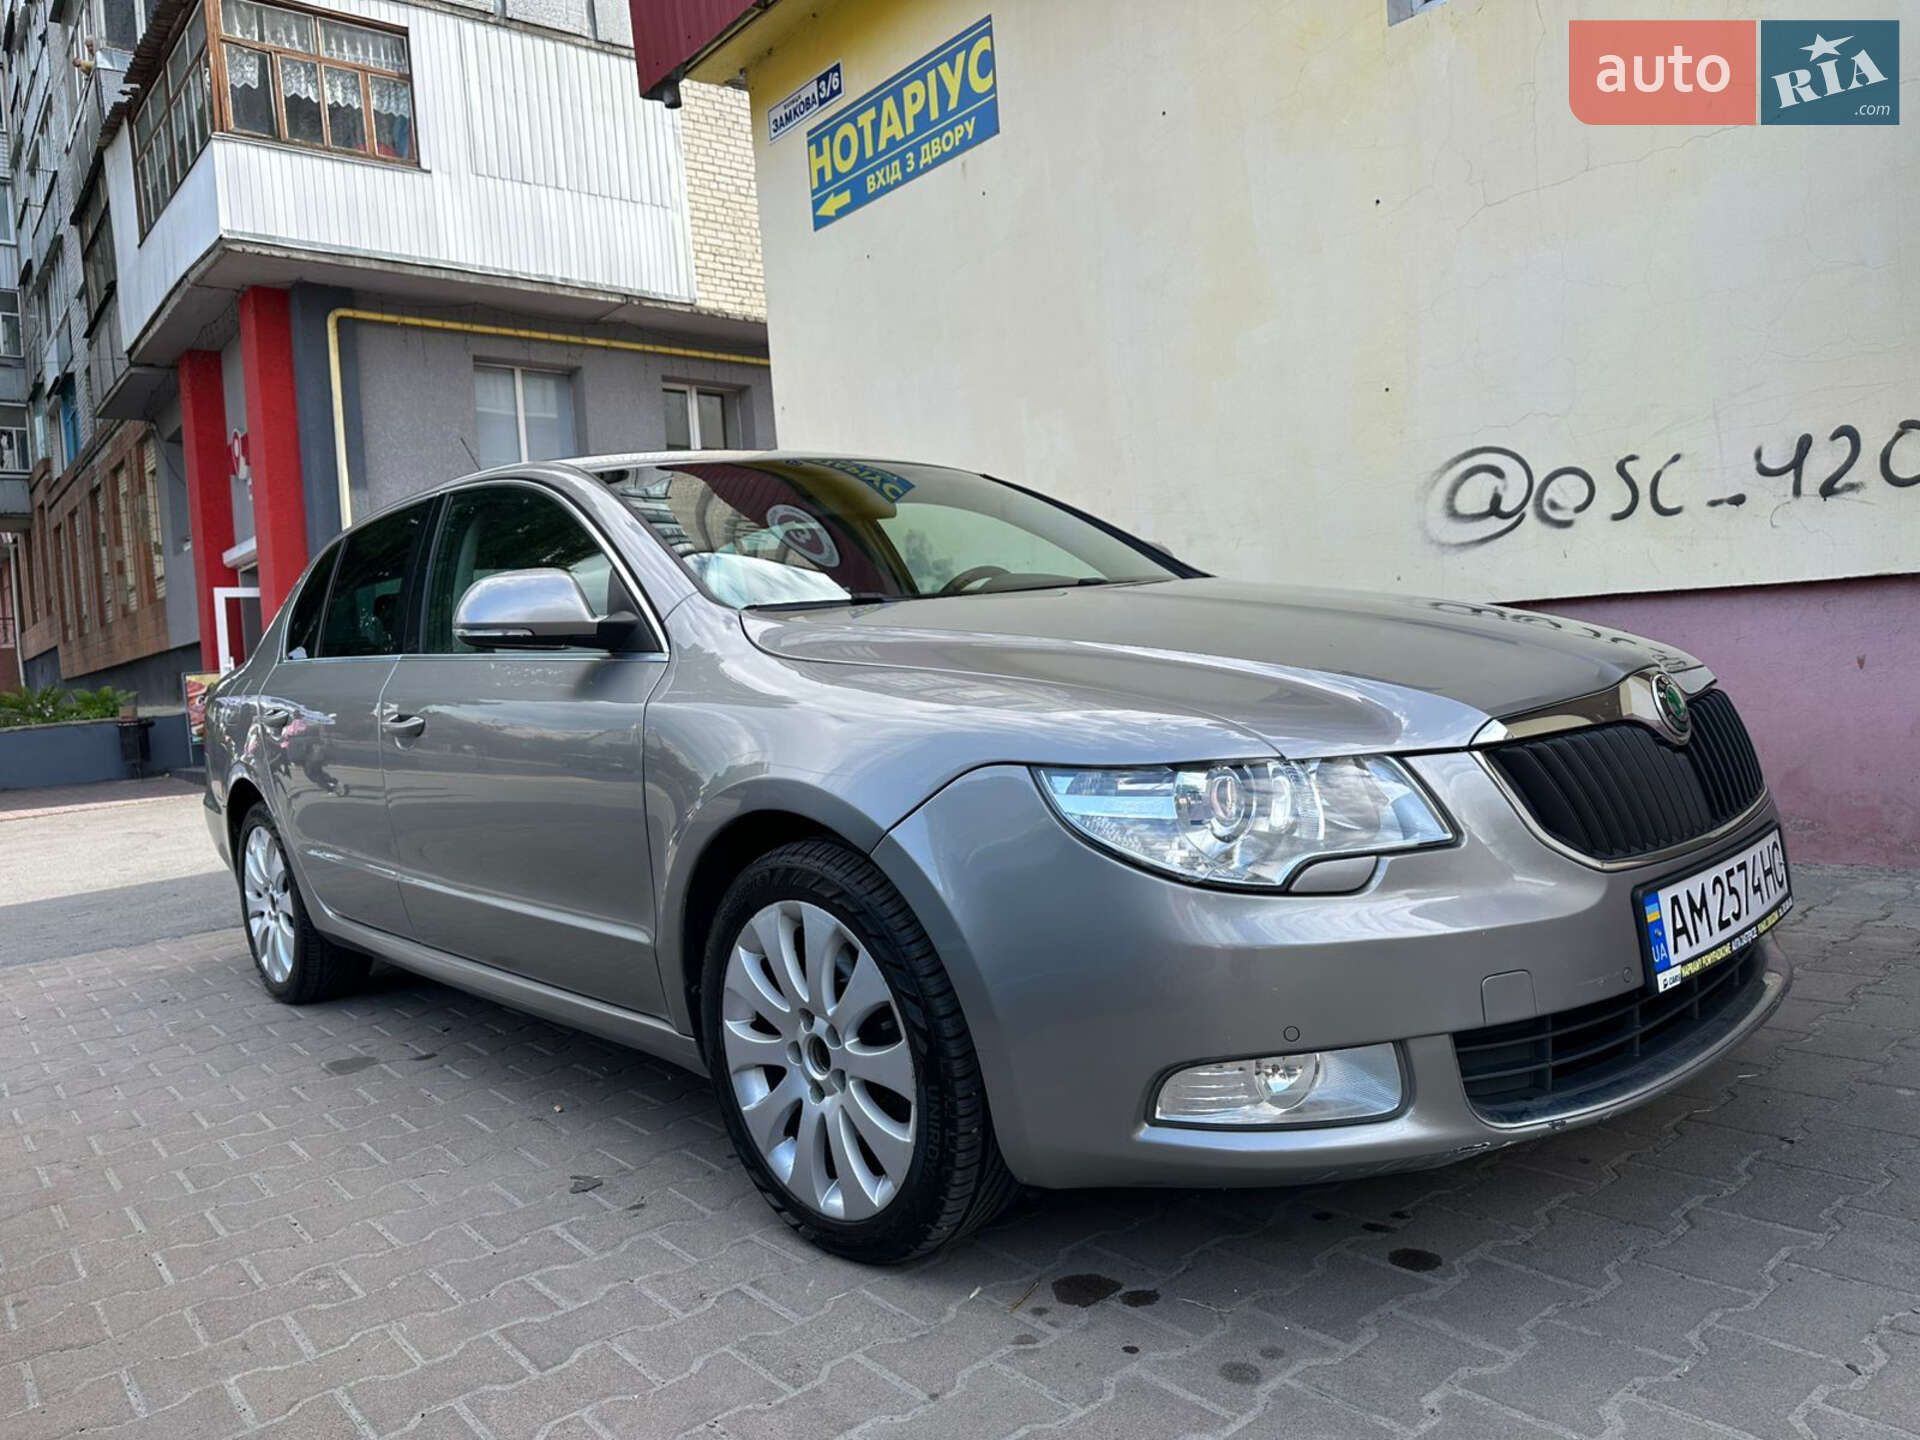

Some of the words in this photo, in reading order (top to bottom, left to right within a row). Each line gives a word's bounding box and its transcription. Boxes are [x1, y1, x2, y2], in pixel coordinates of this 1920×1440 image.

[772, 93, 818, 133] ЗАМКОВА
[819, 72, 840, 98] 3/6
[808, 36, 994, 189] НОТАРІУС
[866, 162, 902, 194] ВХІД
[920, 117, 976, 169] ДВОРУ
[1651, 943, 1668, 963] UA
